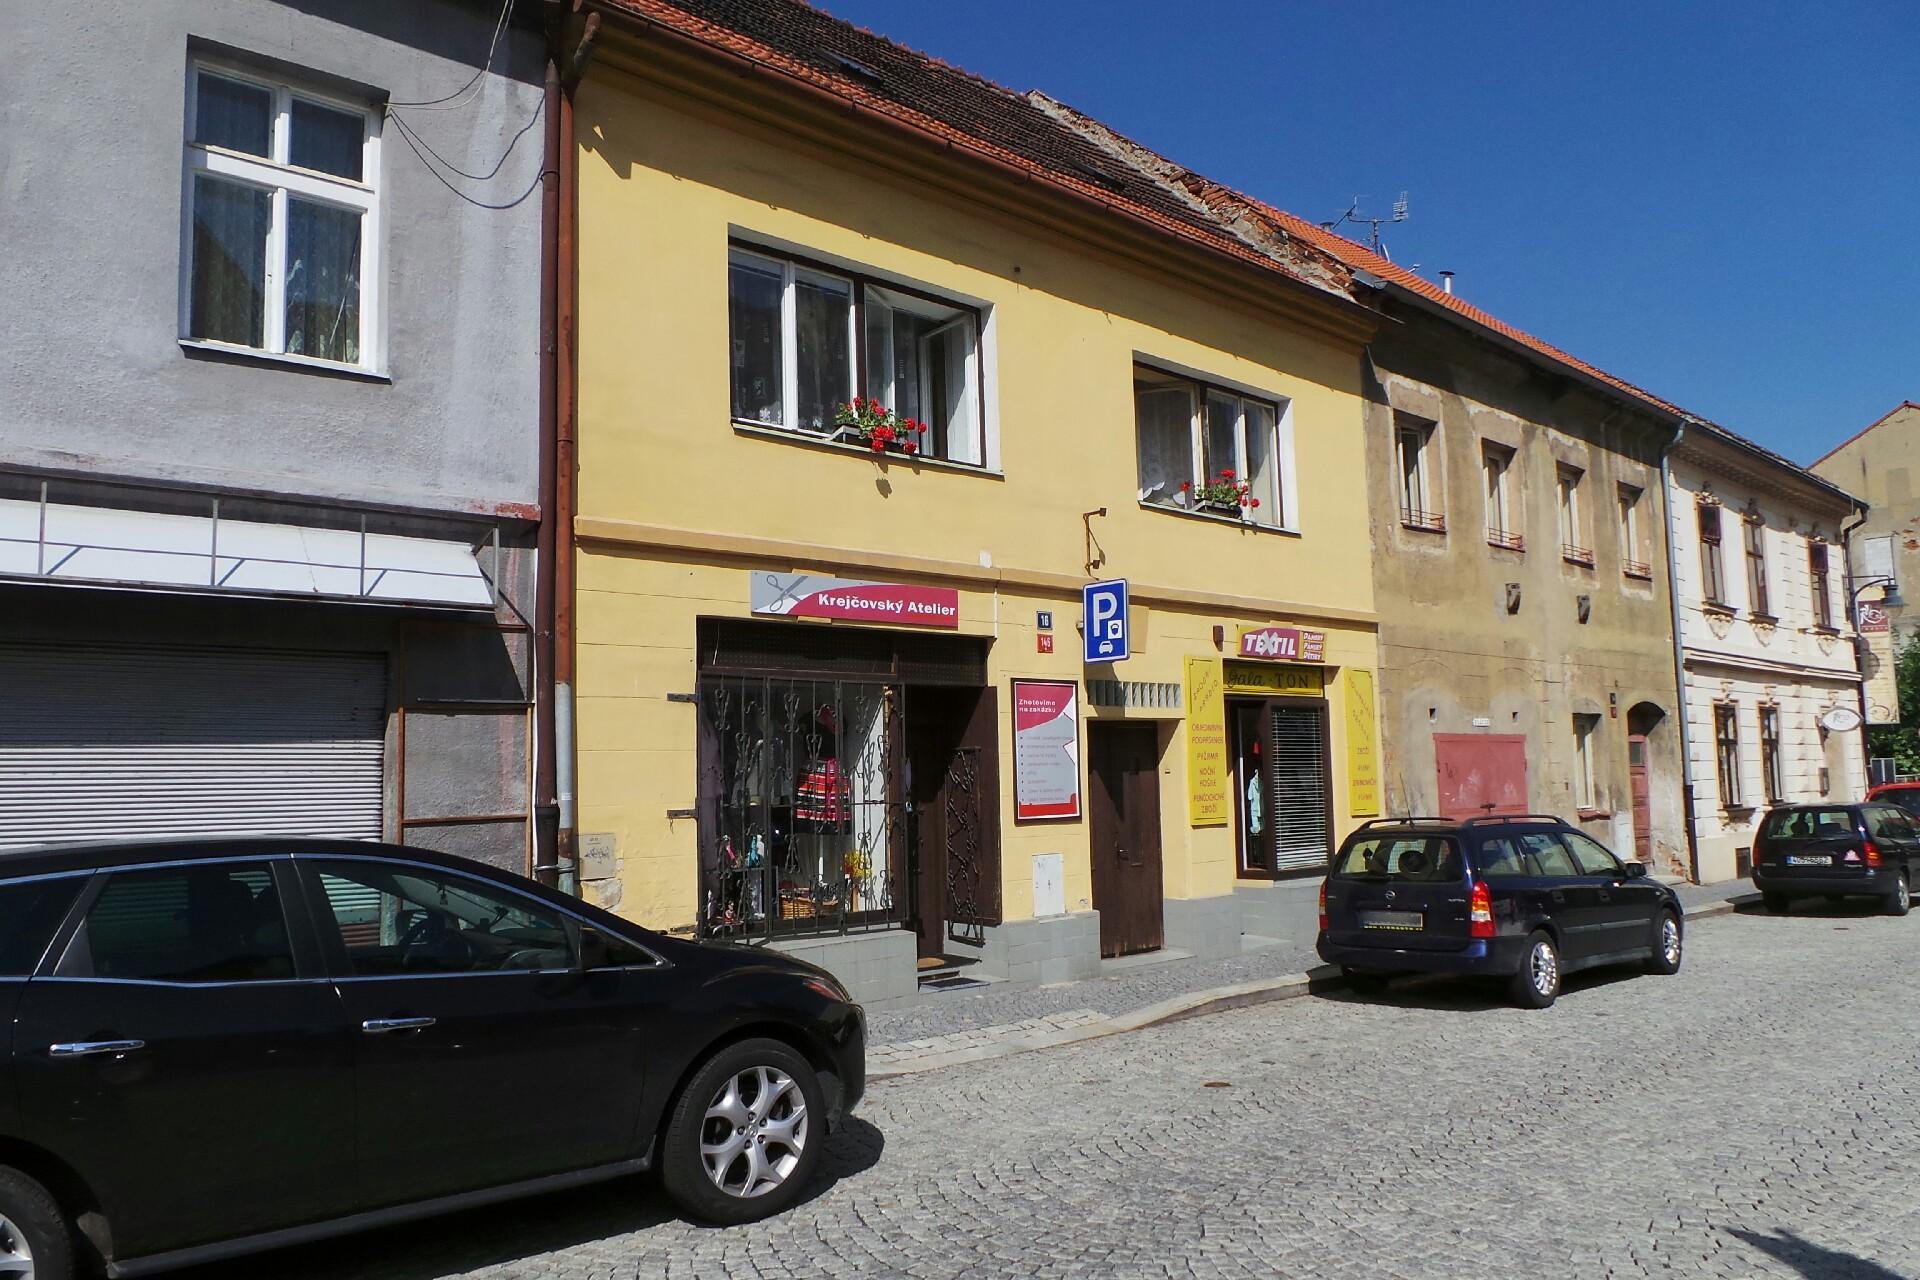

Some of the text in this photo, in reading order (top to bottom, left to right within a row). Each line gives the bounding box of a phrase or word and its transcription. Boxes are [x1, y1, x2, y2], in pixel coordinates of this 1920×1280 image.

[818, 593, 956, 616] Krejčovský Atelier
[1093, 592, 1117, 637] P
[1244, 630, 1296, 656] TEXTIL
[1274, 672, 1309, 689] TON
